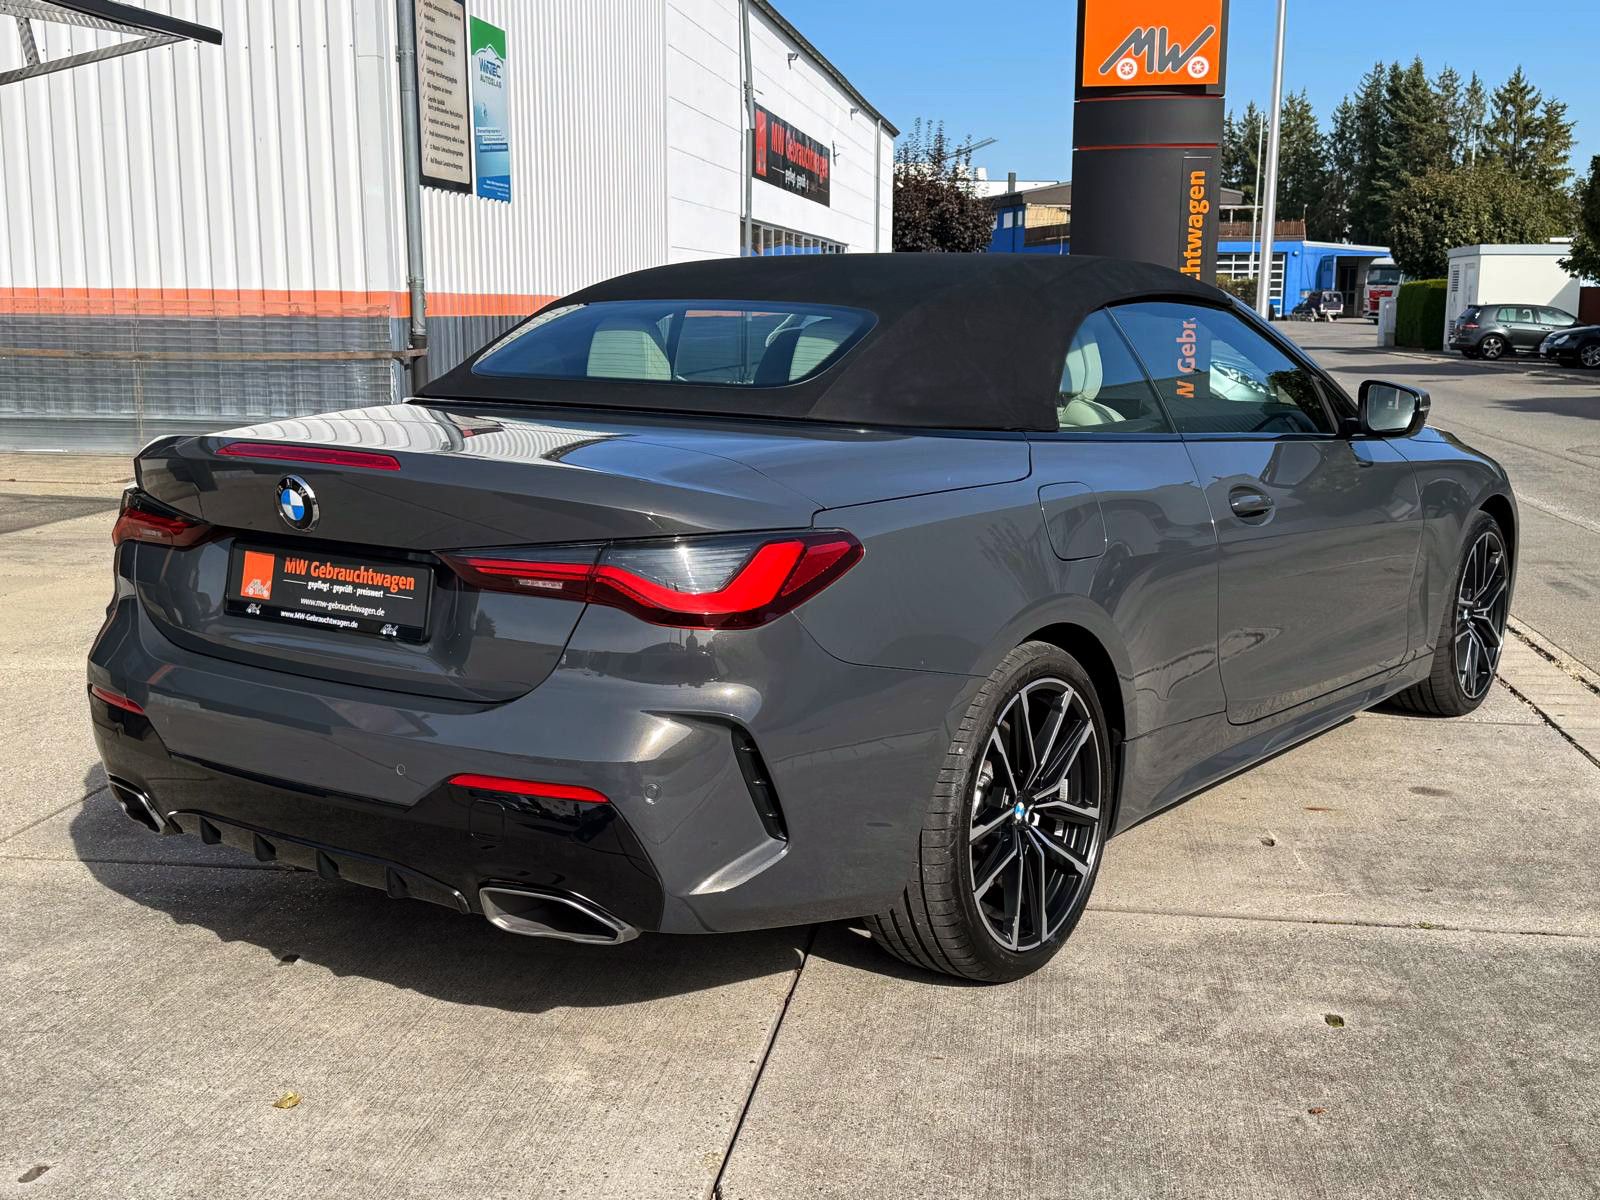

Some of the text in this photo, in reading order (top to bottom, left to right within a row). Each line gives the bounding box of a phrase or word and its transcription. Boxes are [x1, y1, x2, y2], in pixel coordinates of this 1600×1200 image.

[1098, 24, 1216, 76] MW
[1180, 170, 1210, 281] htwagen
[1176, 317, 1197, 374] Gebr
[284, 557, 415, 592] MW Gebrauchtwagen
[307, 580, 384, 598] gepflegt geprüft preiswert
[280, 610, 359, 629] www.MW-Gebrauchtwagen.de
[300, 597, 385, 617] www.mw-gebrauchtwagen.de
